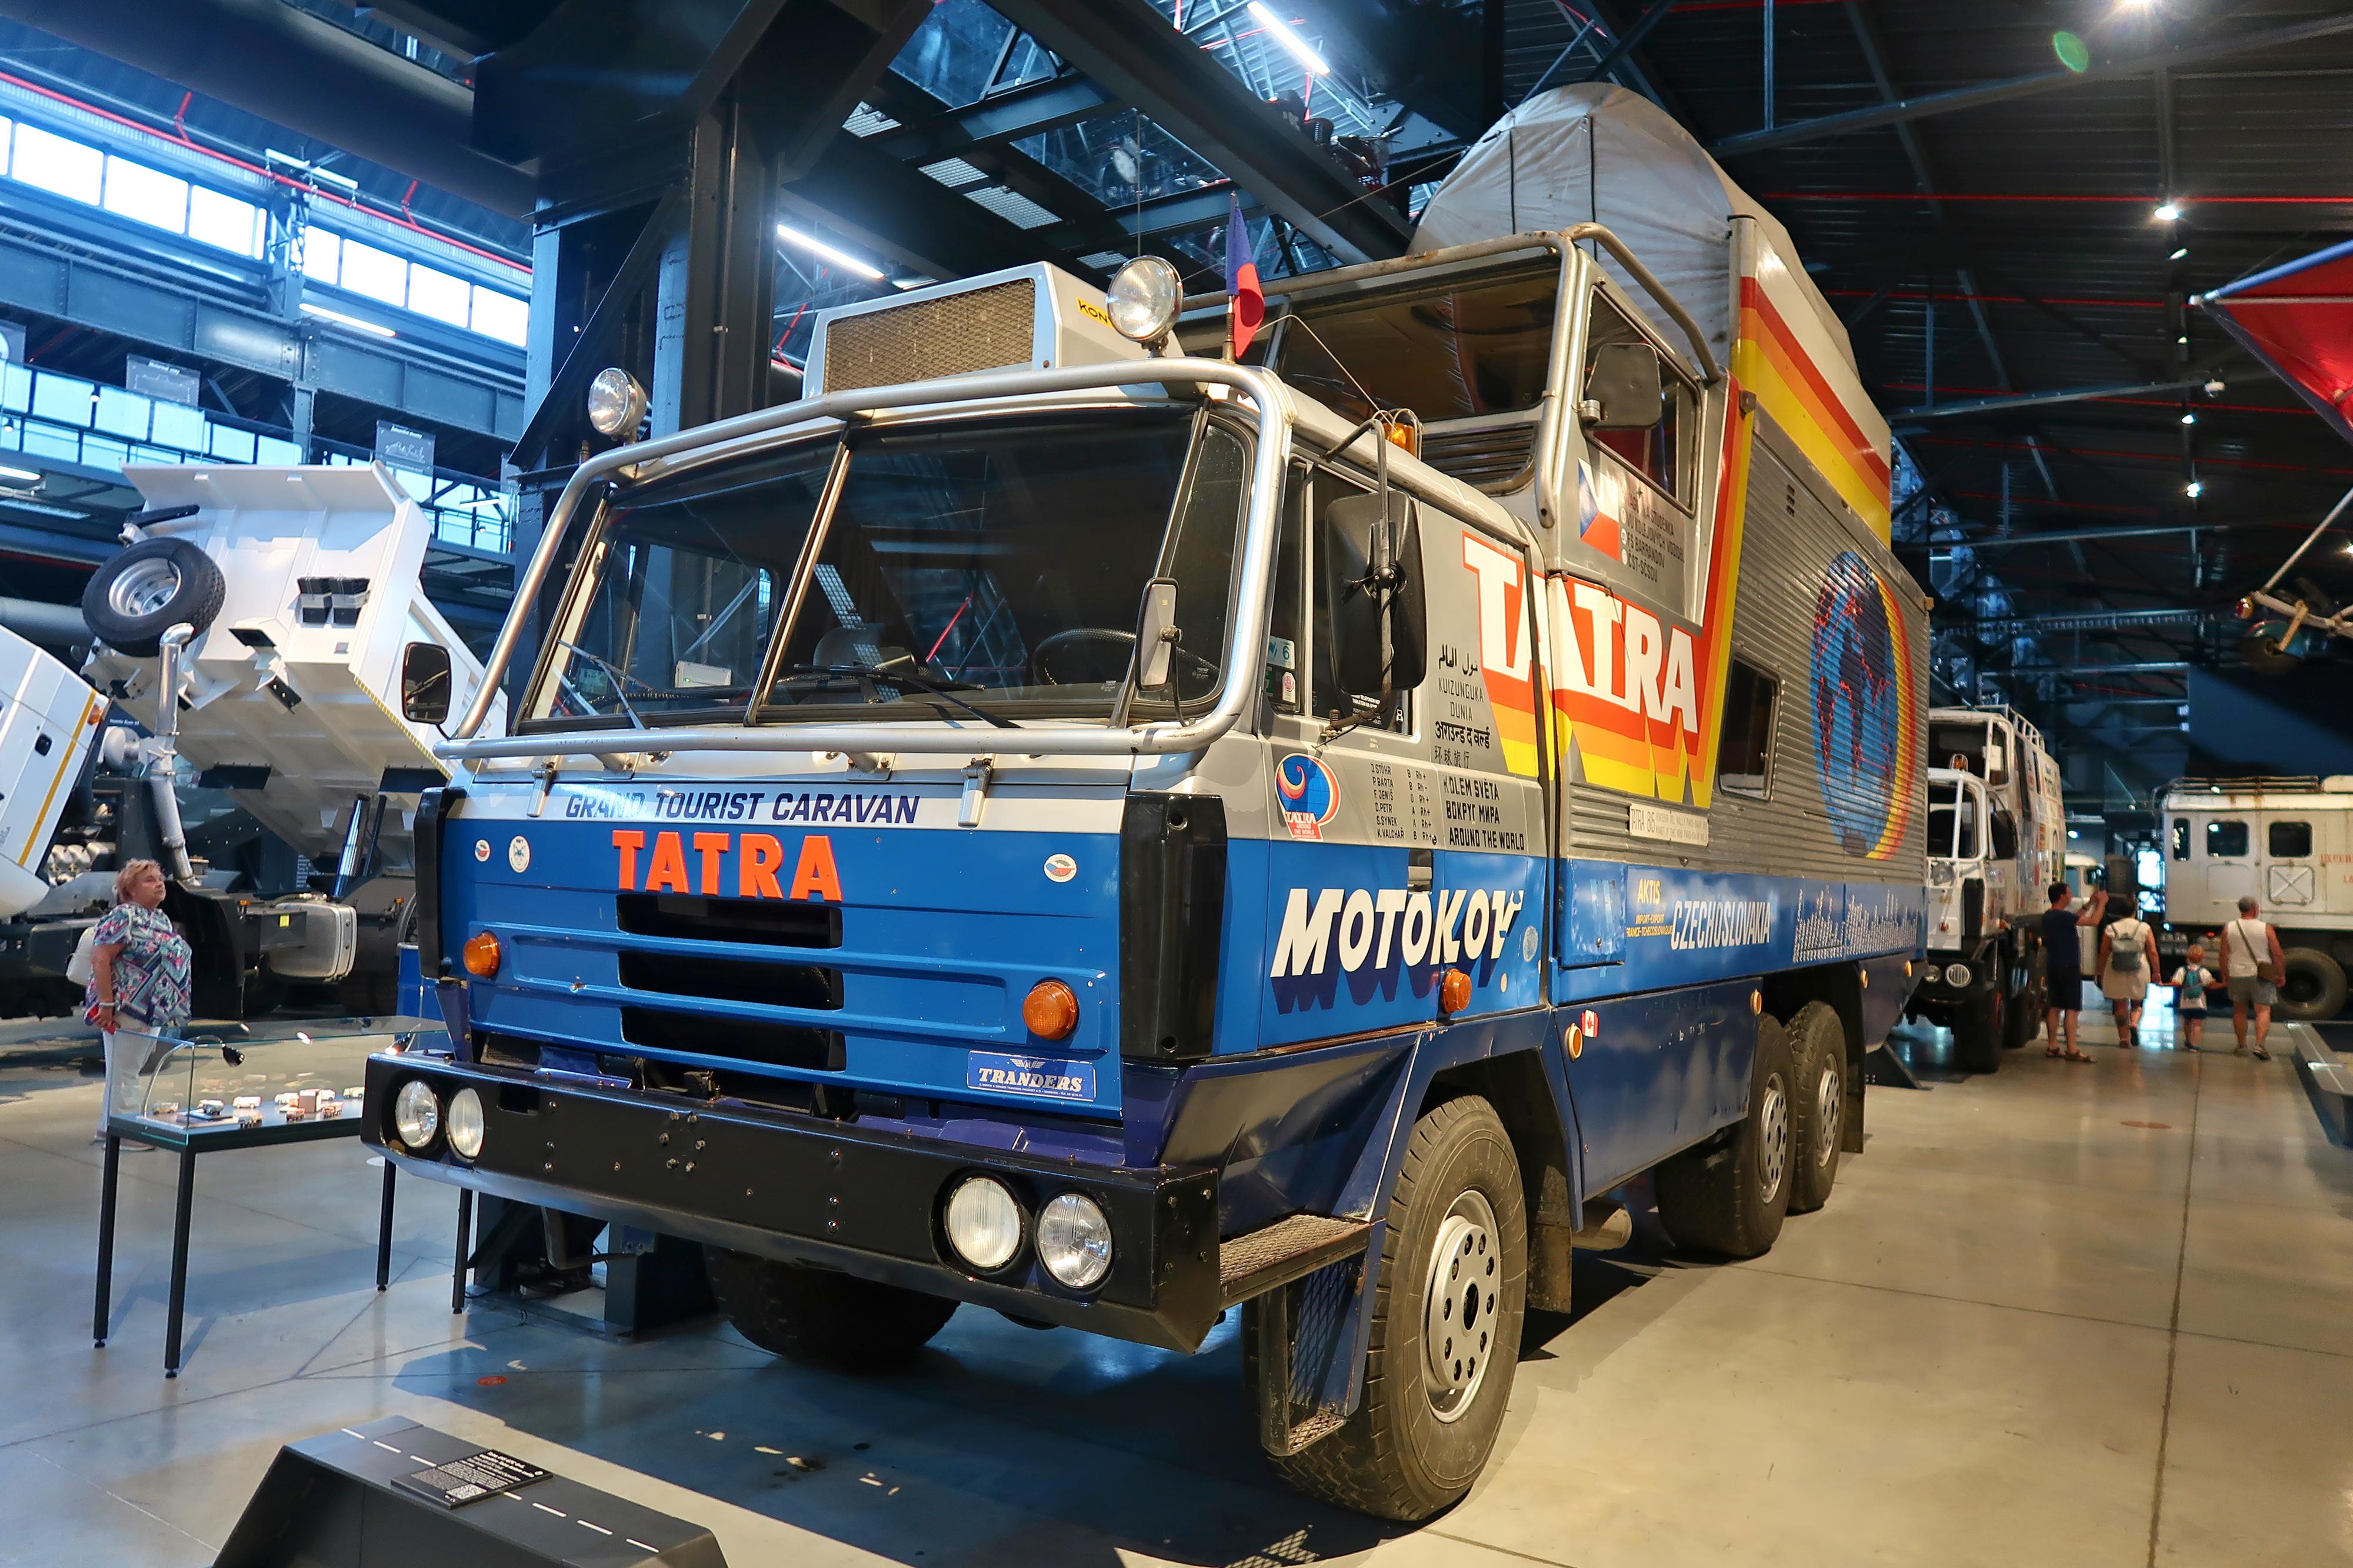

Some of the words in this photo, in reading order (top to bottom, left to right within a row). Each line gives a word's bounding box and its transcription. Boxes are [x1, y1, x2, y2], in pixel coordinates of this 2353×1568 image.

[1078, 300, 1108, 323] KON
[1464, 536, 1698, 734] TATRA
[1449, 701, 1472, 721] DUNIA
[565, 792, 645, 818] GRAND
[654, 792, 765, 820] TOURIST
[772, 792, 920, 823] CARAVAN
[1412, 806, 1416, 815] A
[1446, 800, 1475, 821] ВОКРУГ
[1478, 804, 1500, 824] МИРА
[1413, 819, 1417, 828] A
[1449, 827, 1481, 848] AROUND
[1482, 830, 1498, 849] THE
[1499, 832, 1525, 851] WORLD
[612, 829, 844, 902] TATRA
[1637, 879, 1661, 905] AKTIS
[1270, 888, 1524, 978] MOTOKOV
[1671, 900, 1772, 950] CZECHOSLOVAKIA
[978, 1067, 1083, 1092] TRANDERS
